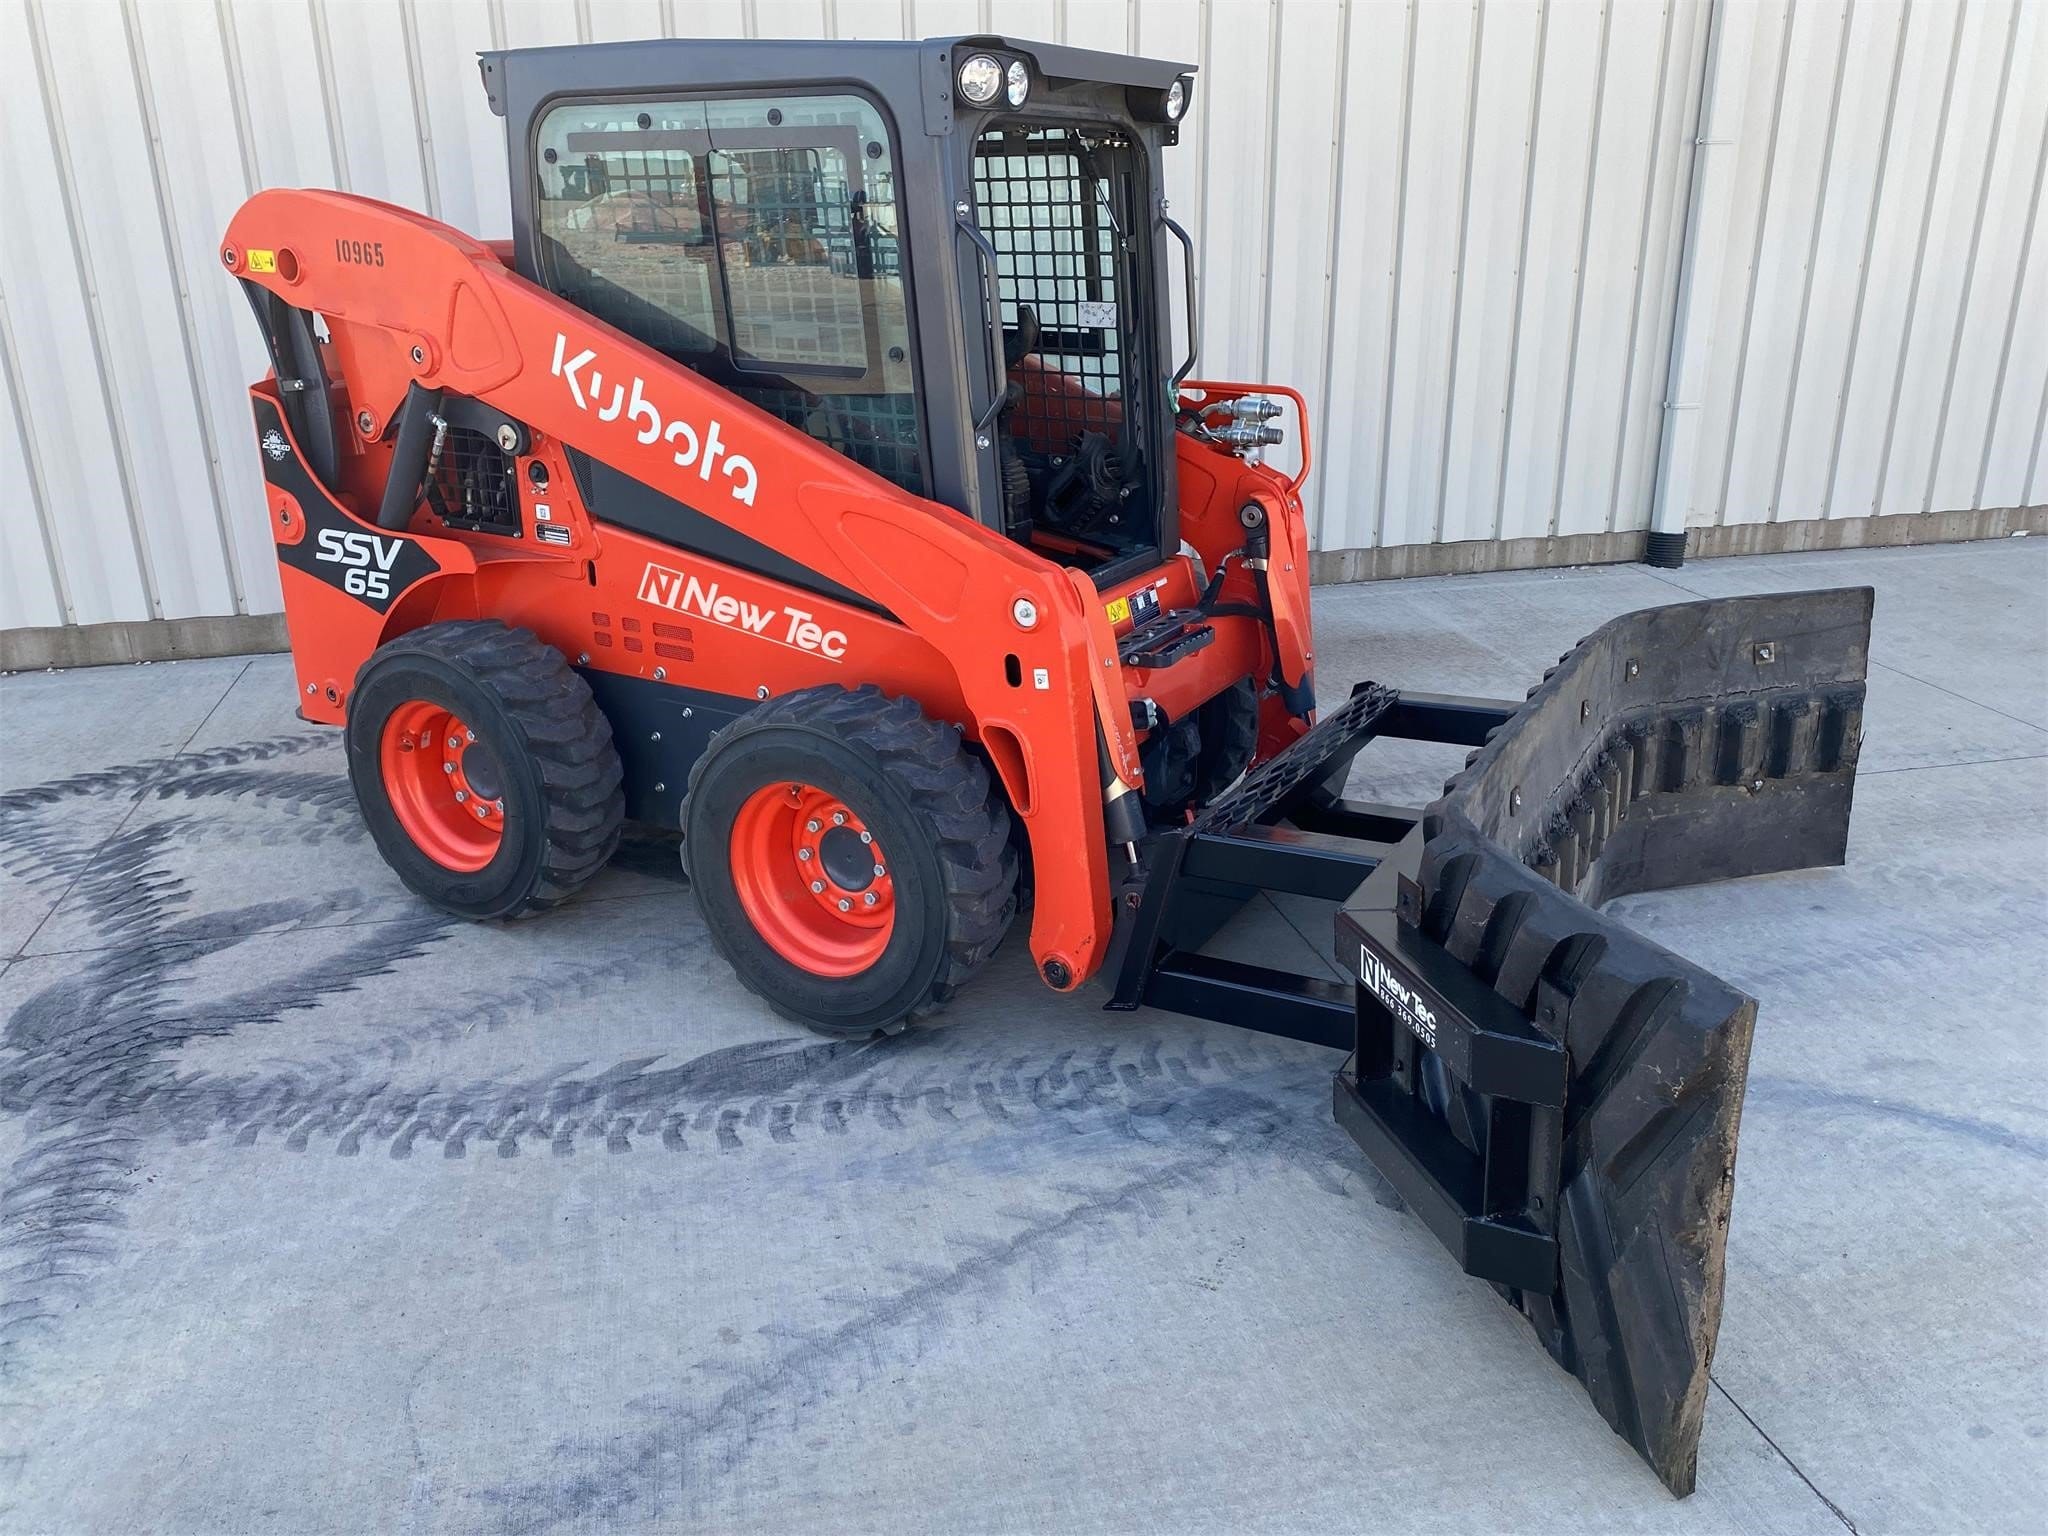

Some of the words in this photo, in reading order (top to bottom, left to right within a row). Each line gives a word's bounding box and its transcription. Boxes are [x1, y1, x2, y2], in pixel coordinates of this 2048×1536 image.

[336, 238, 384, 267] 10965
[551, 332, 758, 506] Kubota
[316, 528, 403, 570] SSV
[345, 568, 390, 599] 65
[681, 576, 776, 634] New
[784, 606, 848, 658] Tec
[1380, 963, 1410, 1005] New
[1412, 991, 1436, 1030] Tec
